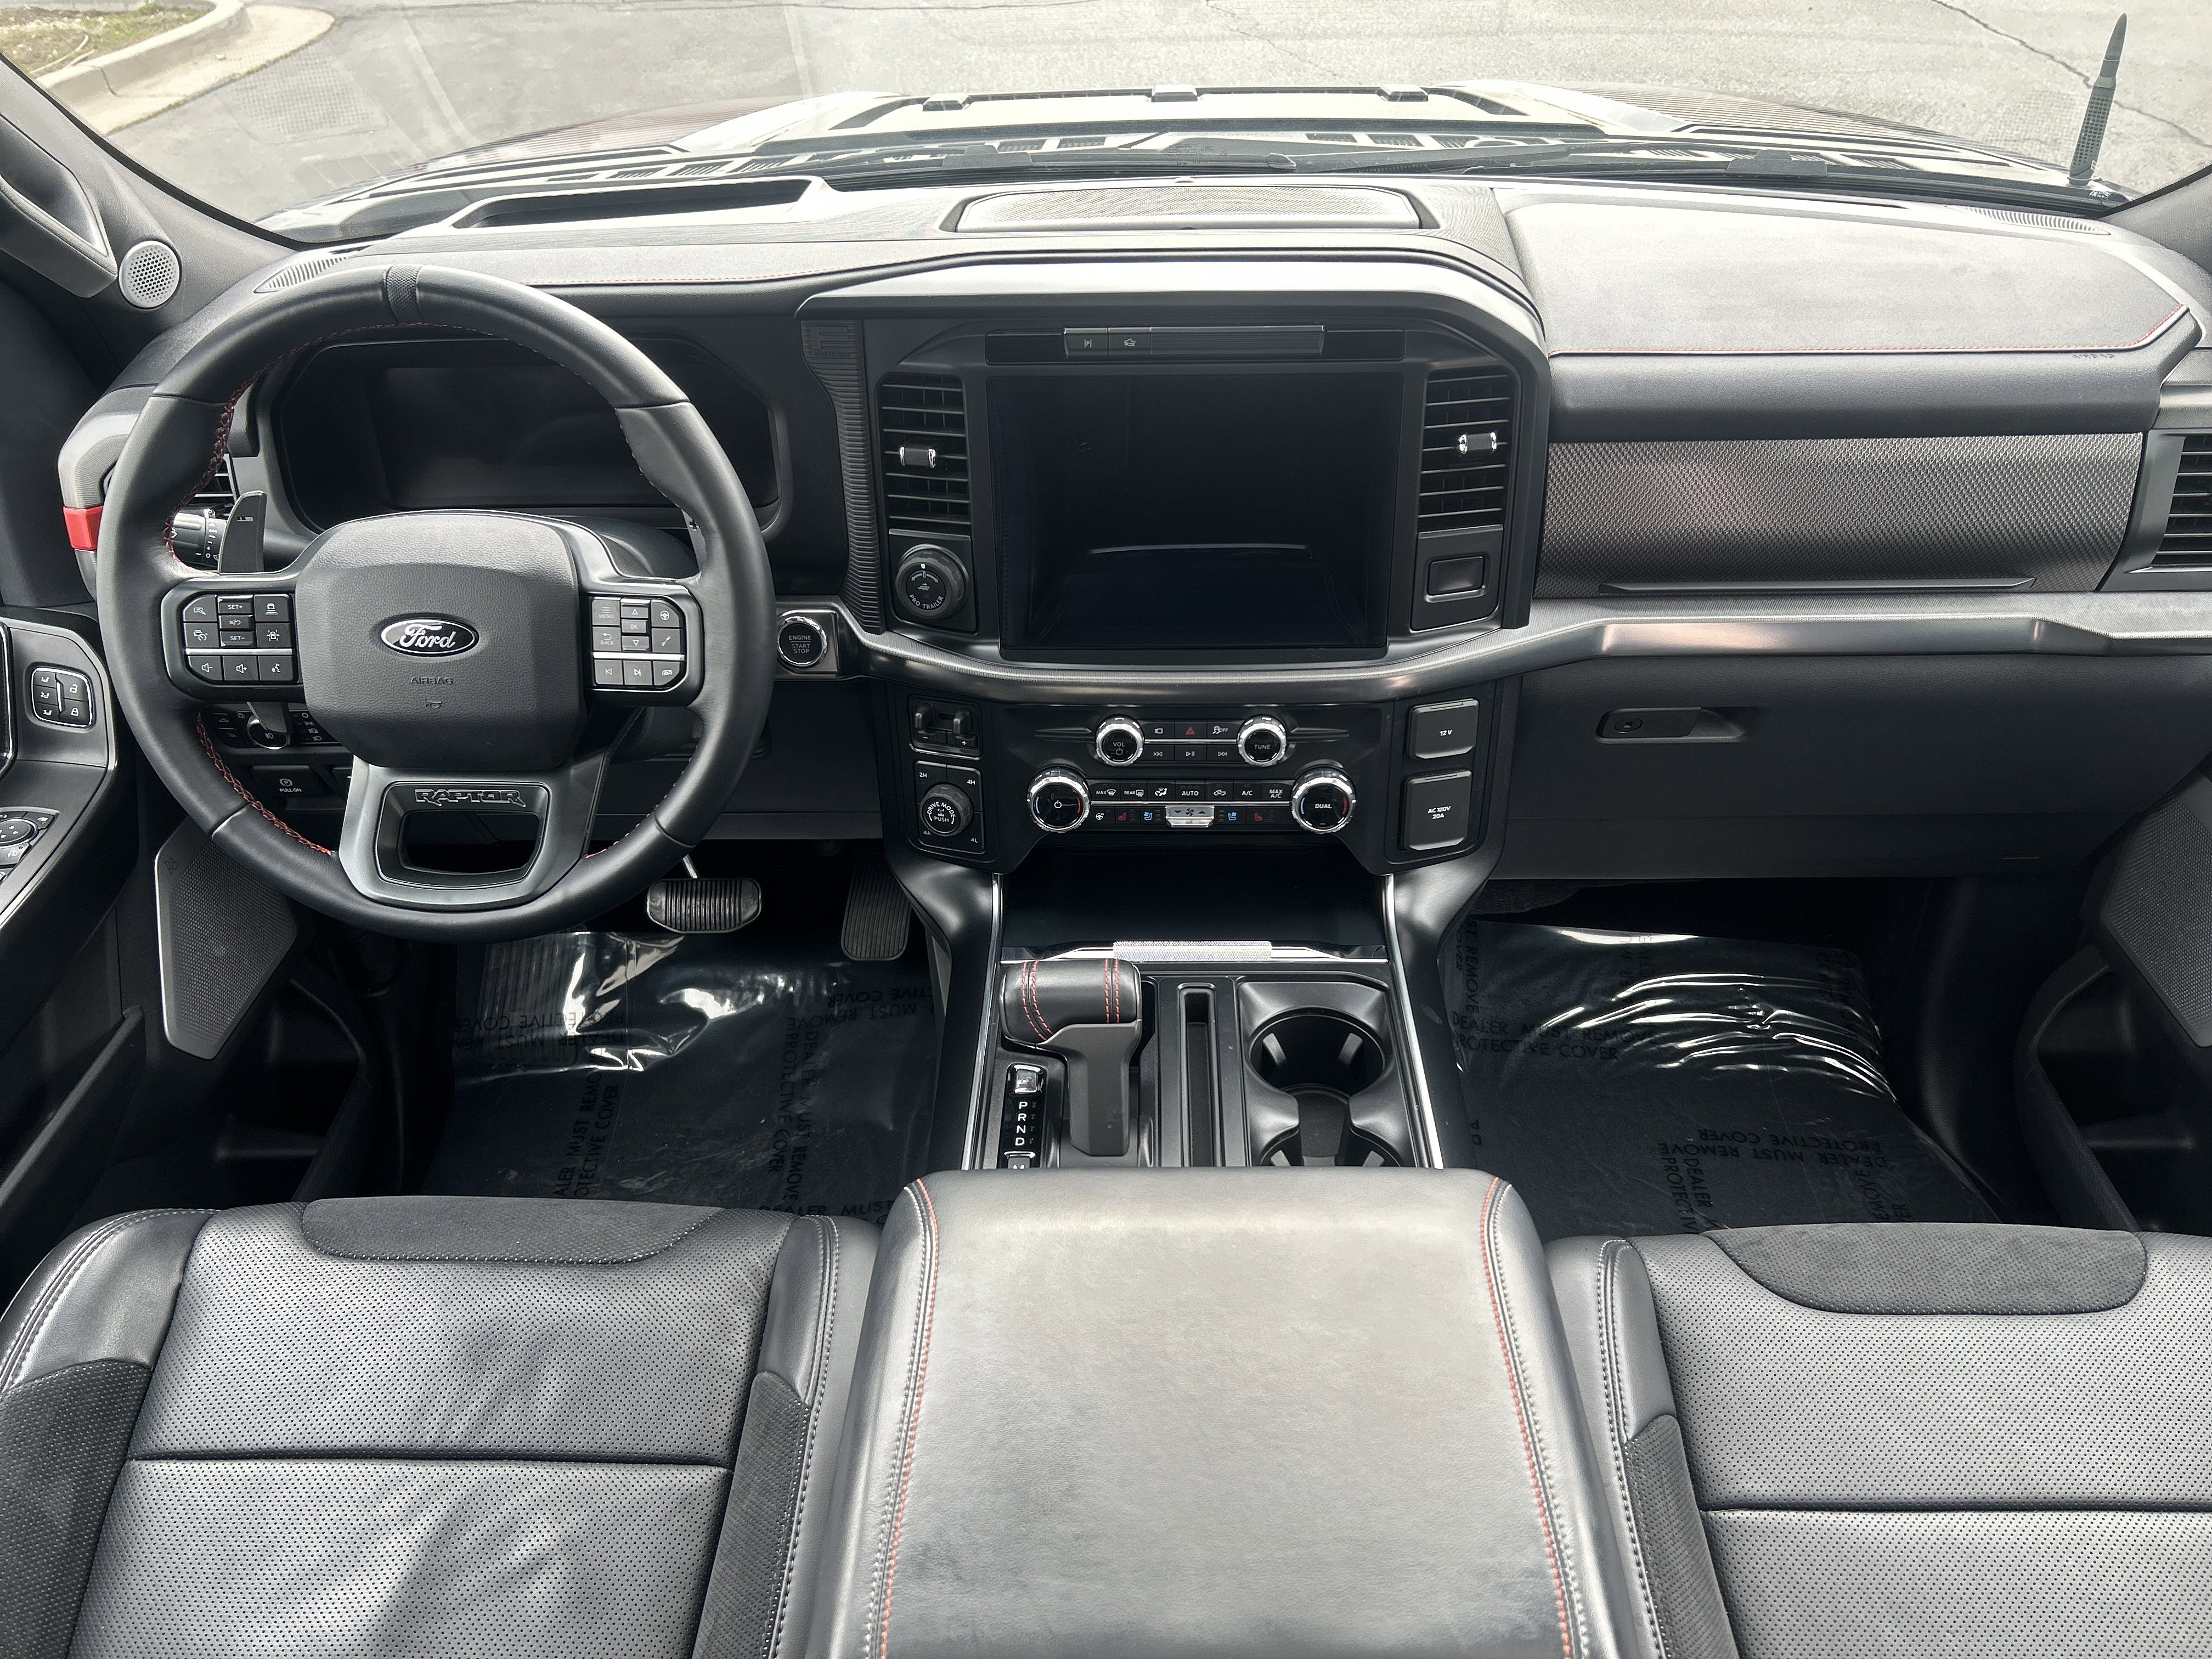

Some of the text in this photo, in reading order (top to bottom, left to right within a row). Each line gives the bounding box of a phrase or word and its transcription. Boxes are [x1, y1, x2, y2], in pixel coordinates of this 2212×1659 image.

[909, 594, 944, 610] PRO TRAILER
[399, 624, 456, 648] Ford
[415, 789, 526, 808] RAPTOR
[927, 802, 956, 817] DRIVE MODE
[1465, 945, 1479, 1014] REMOVE
[828, 990, 883, 1008] COVER
[869, 1003, 917, 1020] MUST
[1453, 1011, 1509, 1036] DEALER
[1559, 1043, 1620, 1061] COVER
[595, 1085, 619, 1130] COVER
[769, 1032, 799, 1172] PROTECTIVE COVER
[1019, 1101, 1028, 1109] P
[783, 1031, 819, 1201] DEALER MUST REMOVE
[1018, 1113, 1027, 1121] R
[566, 1119, 590, 1156] MUST
[1016, 1125, 1026, 1133] N
[1015, 1137, 1025, 1146] D
[1699, 1128, 1881, 1154] PROTECTIVE COVER
[1658, 1142, 1888, 1168] DEALER MUST REMOVE
[1684, 1158, 1713, 1208] DEALER
